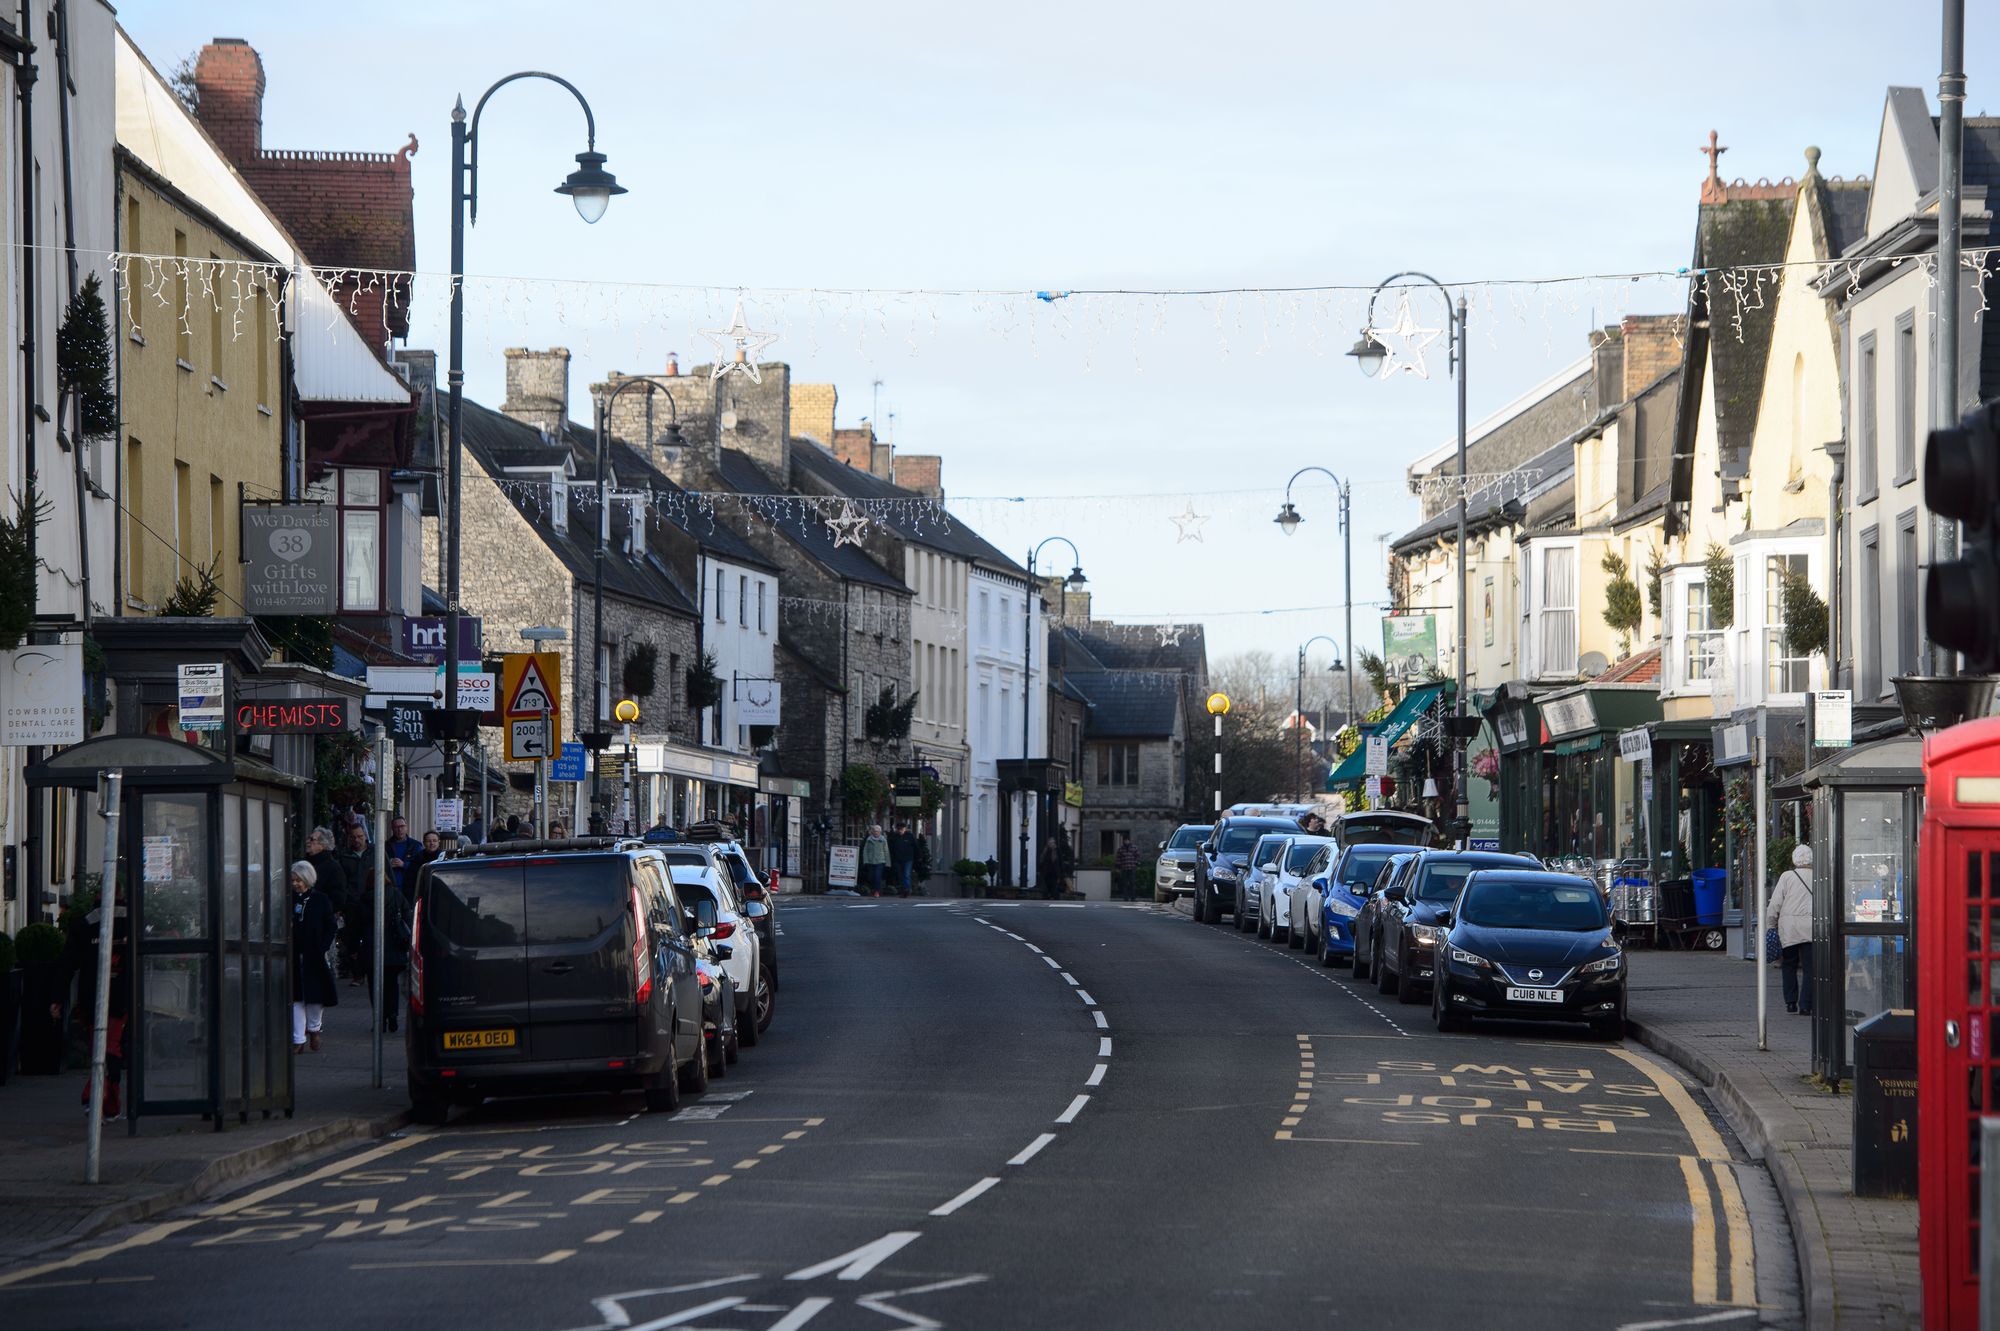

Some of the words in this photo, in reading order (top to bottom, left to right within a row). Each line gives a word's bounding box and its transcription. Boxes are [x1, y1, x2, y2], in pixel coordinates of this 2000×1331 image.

[251, 514, 278, 528] WG
[282, 512, 330, 528] Davies
[278, 535, 304, 554] 38
[264, 563, 317, 580] Gifts
[251, 580, 291, 595] with
[294, 580, 328, 595] love
[255, 596, 287, 606] 01446
[289, 596, 324, 606] 772801
[450, 601, 458, 611] 8
[412, 623, 447, 646] hrt
[457, 679, 491, 689] ESCO
[8, 707, 76, 716] COWBRIDGE
[237, 704, 342, 728] CHEMISTS
[8, 720, 46, 728] DENTAL
[50, 719, 76, 727] CARE
[516, 726, 536, 736] 200
[1513, 989, 1535, 999] CU18
[1537, 990, 1558, 1001] NLE
[449, 1034, 481, 1047] WK64
[484, 1032, 509, 1044] OEO
[1376, 1061, 1595, 1080] BWS
[1880, 1080, 1918, 1089] YSBWRIE
[1884, 1089, 1915, 1097] LITTER
[1344, 1094, 1651, 1118] STOP
[1381, 1110, 1617, 1134] BUS
[417, 1140, 708, 1165] BUS
[322, 1157, 714, 1188] STOP
[191, 1213, 568, 1247] BWS
